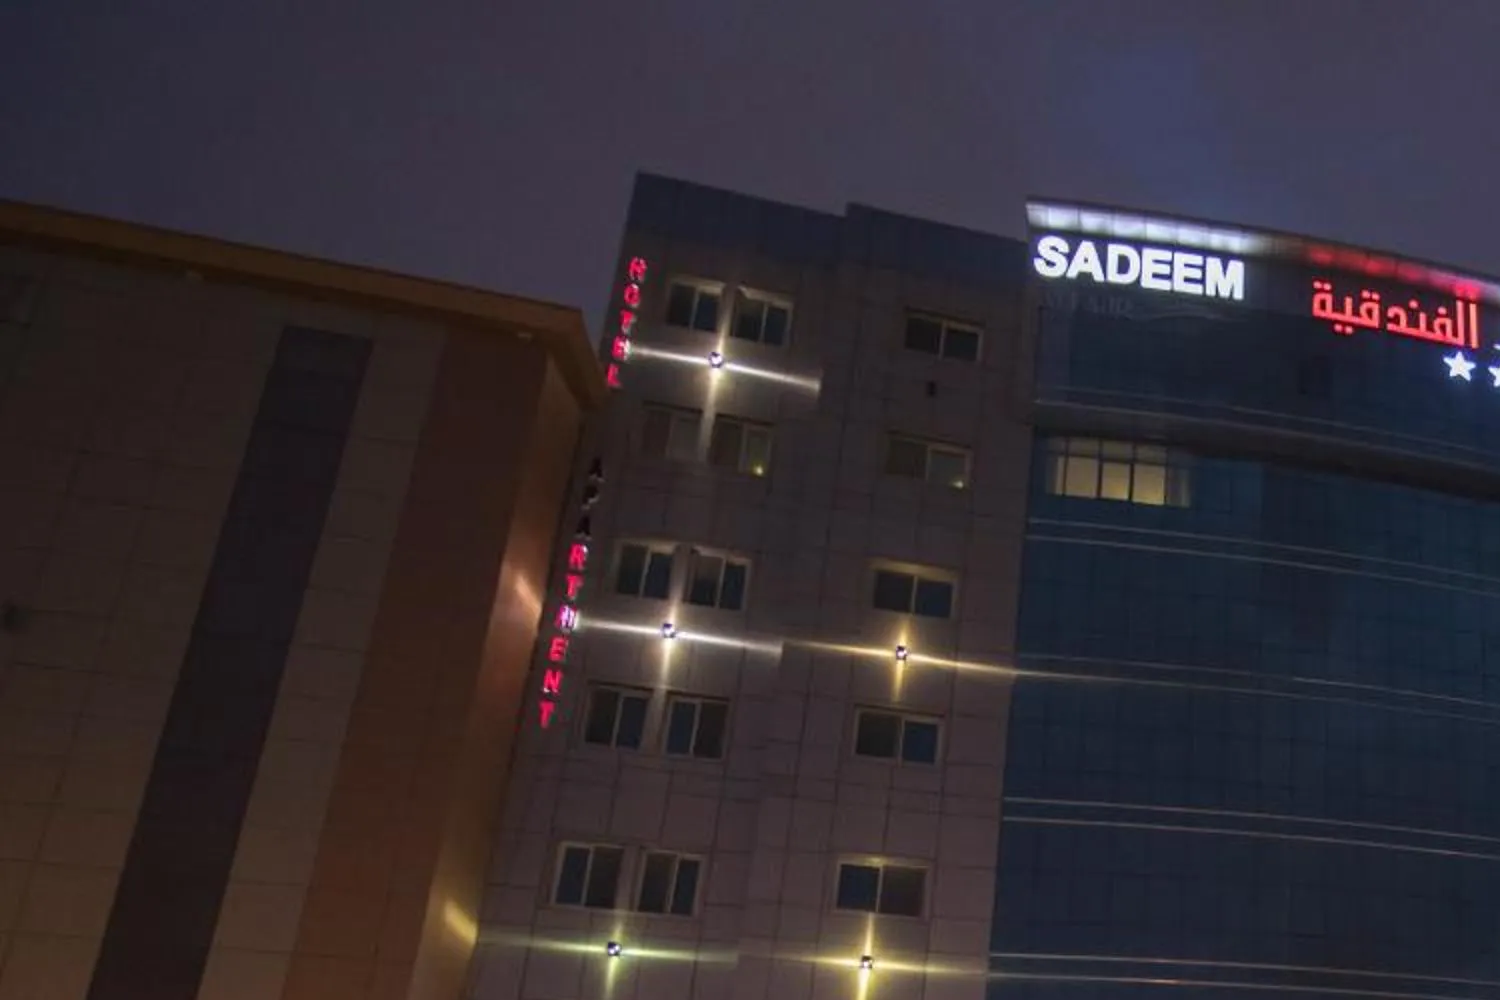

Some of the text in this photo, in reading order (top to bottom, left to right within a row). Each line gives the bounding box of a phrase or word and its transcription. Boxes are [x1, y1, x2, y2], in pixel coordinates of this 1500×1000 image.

[1032, 236, 1246, 301] SADEEM
[606, 256, 648, 388] HOTEL
[1311, 280, 1480, 349] الفندقية
